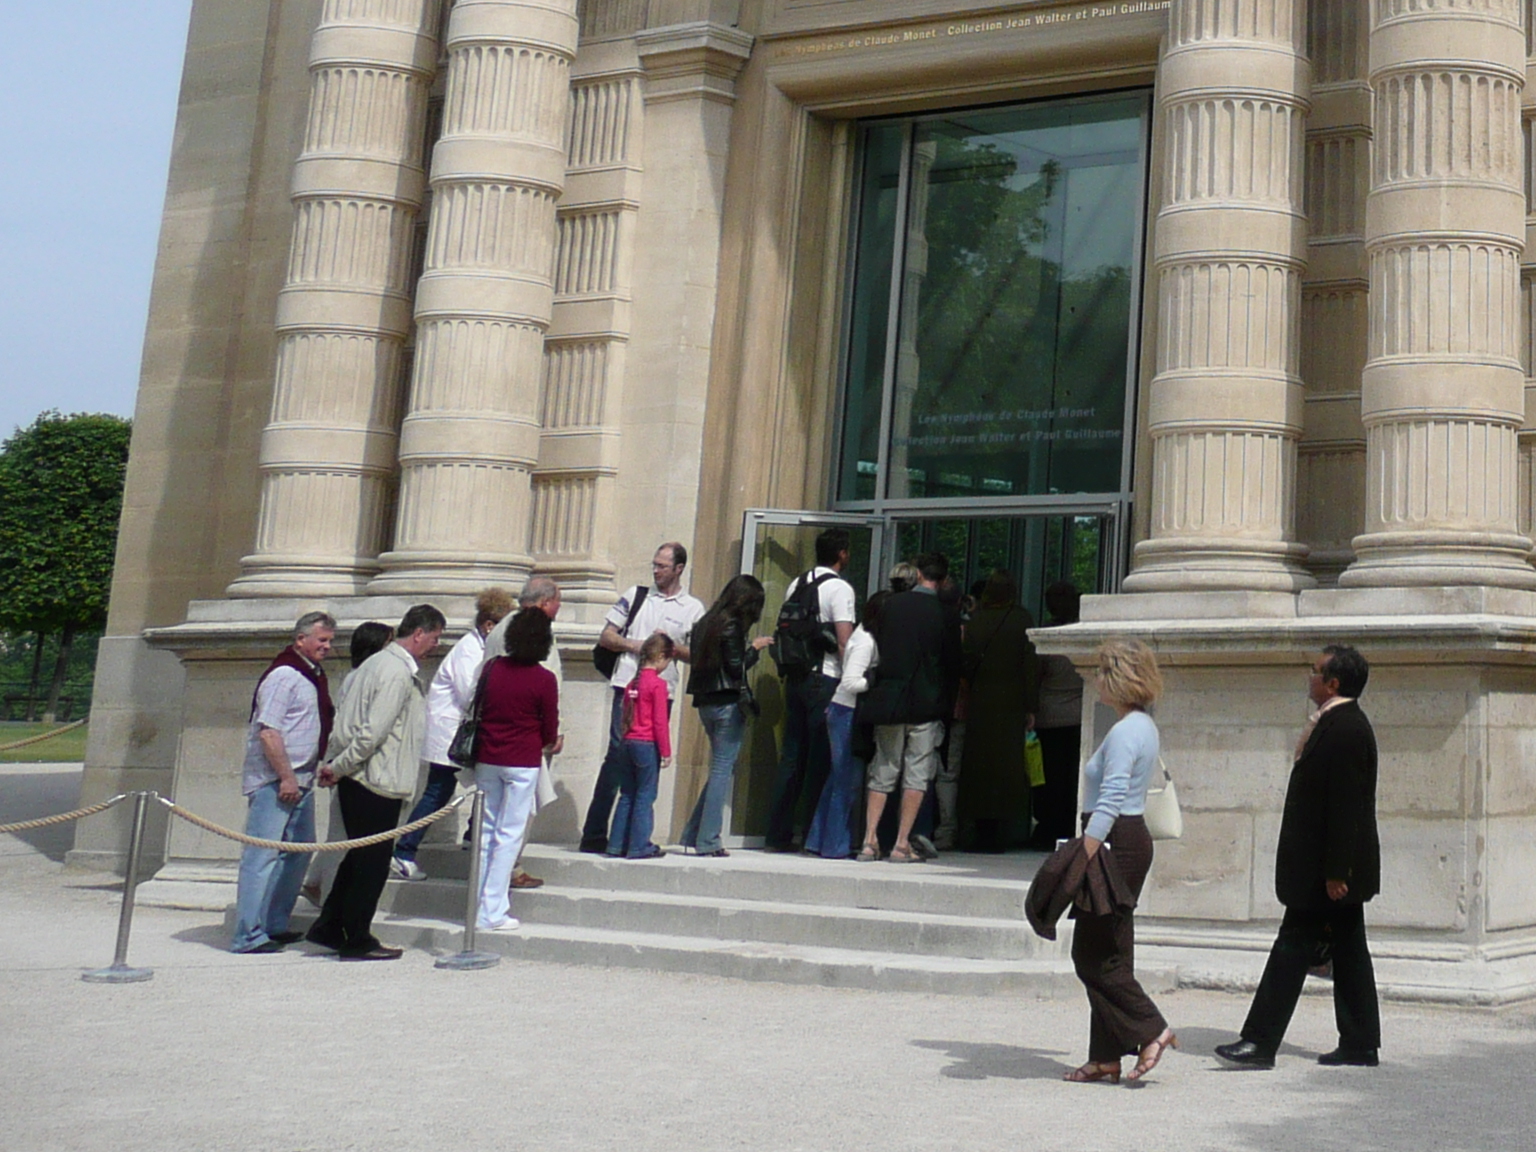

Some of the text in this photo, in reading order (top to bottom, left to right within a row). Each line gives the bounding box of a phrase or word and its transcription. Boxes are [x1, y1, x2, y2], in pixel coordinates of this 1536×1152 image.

[848, 37, 861, 48] de
[864, 34, 900, 46] Claude
[903, 28, 937, 42] Monet
[948, 22, 1002, 36] Collection
[1006, 16, 1031, 29] Jean
[1035, 12, 1071, 25] Walter
[1075, 9, 1087, 20] et
[1091, 5, 1117, 17] Paul
[1120, 0, 1171, 14] Guillaum
